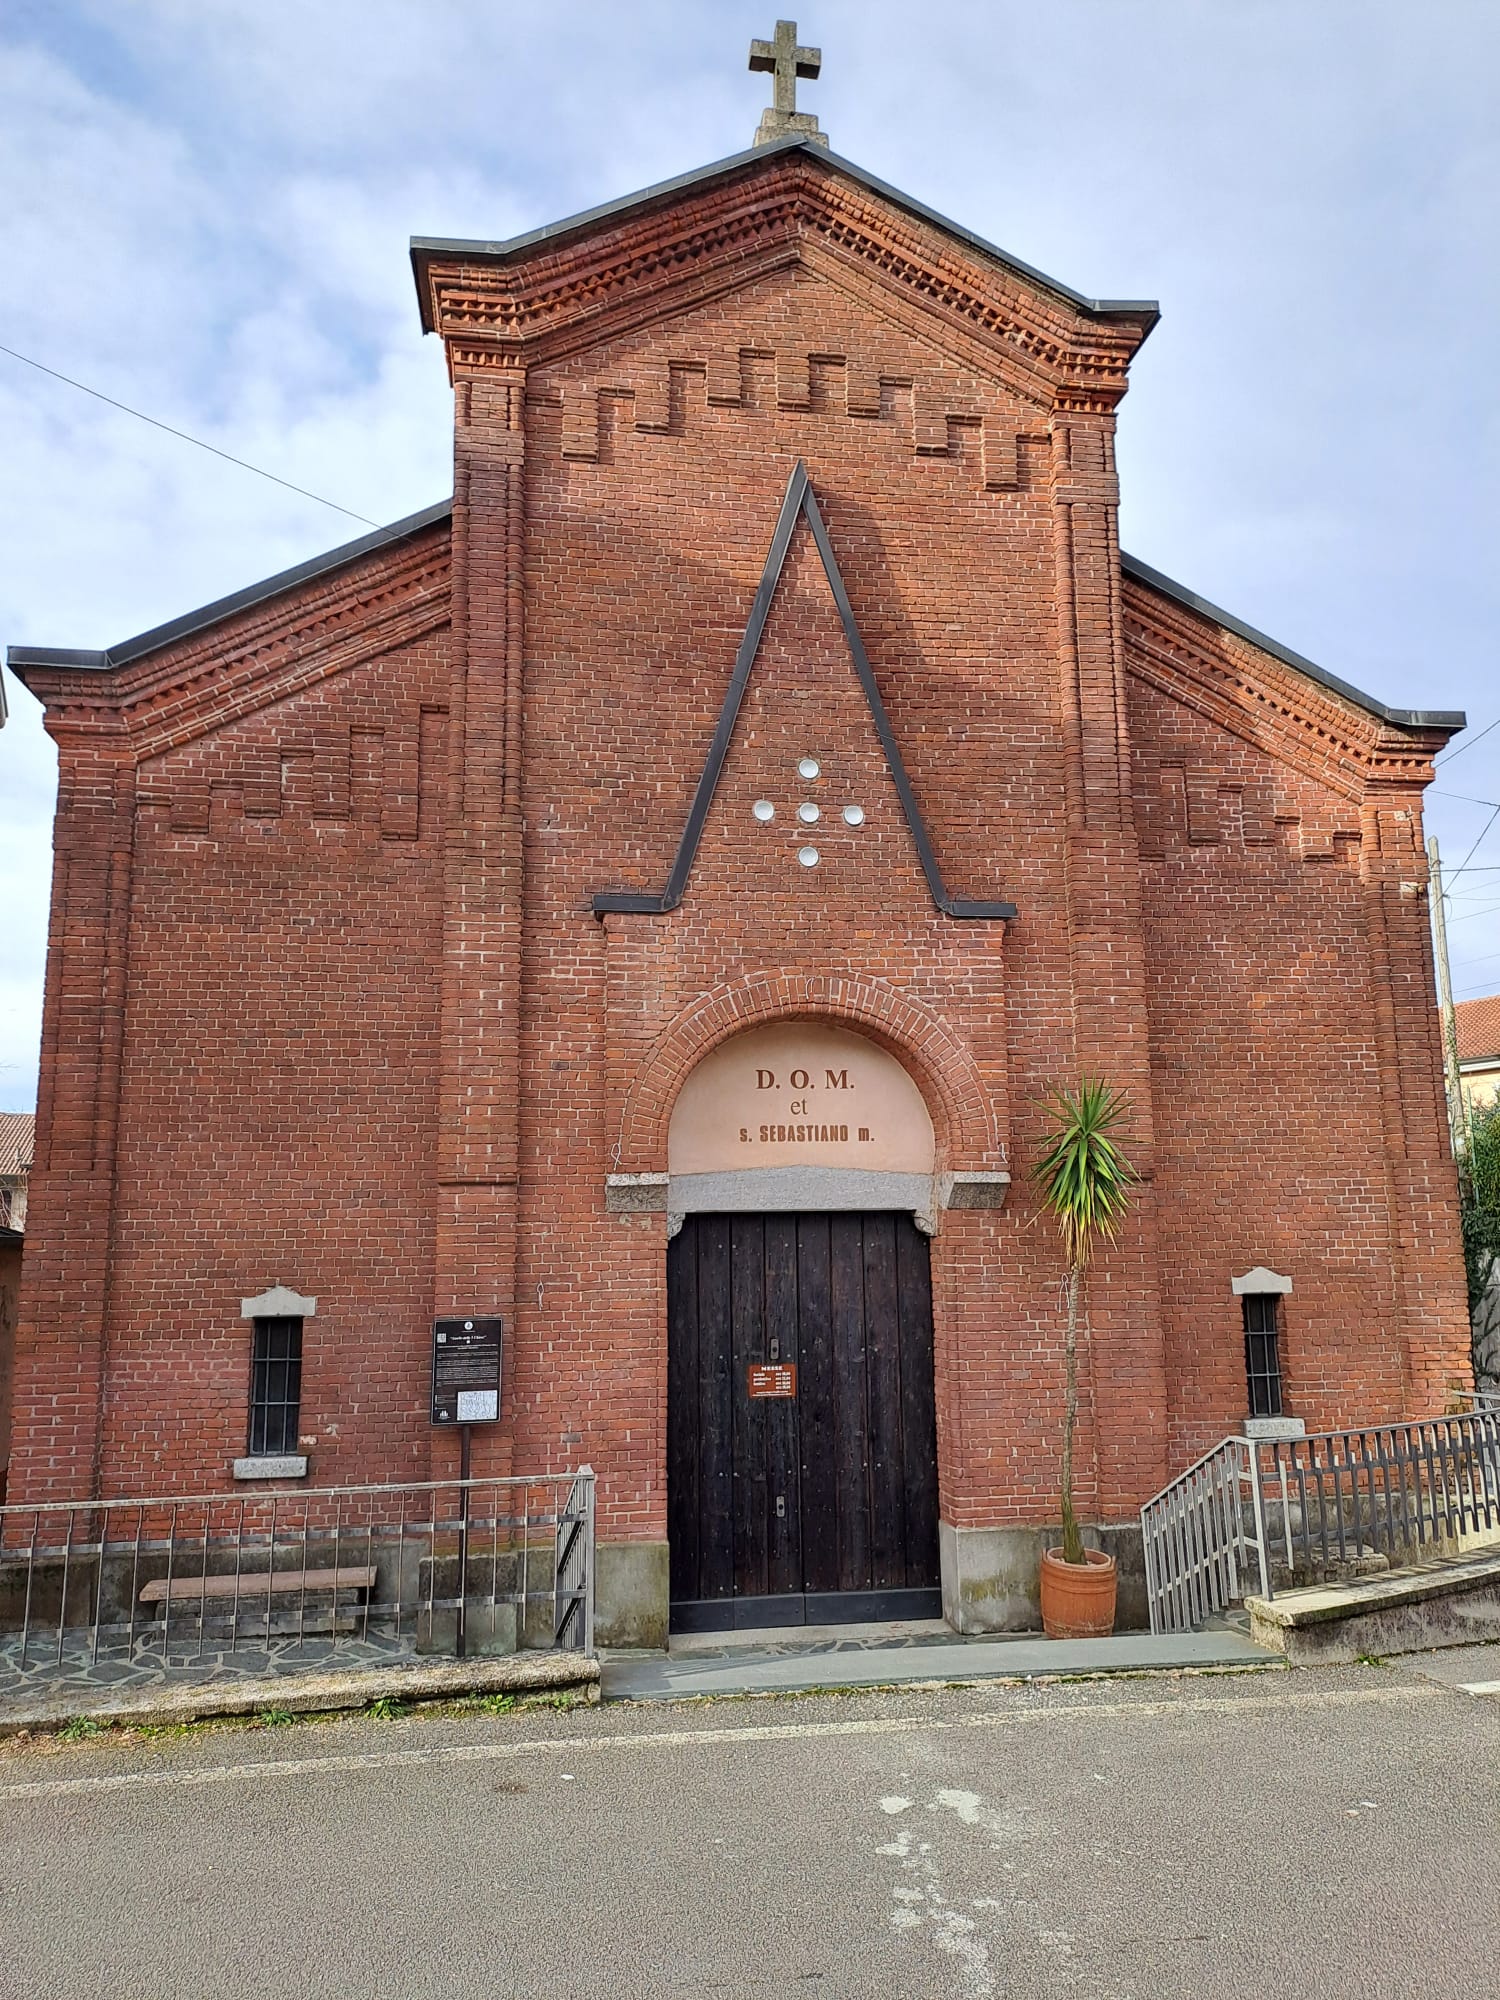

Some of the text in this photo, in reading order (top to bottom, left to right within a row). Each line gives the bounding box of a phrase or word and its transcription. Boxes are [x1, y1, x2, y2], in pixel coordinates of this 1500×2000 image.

[755, 1069, 855, 1089] D. O. M.
[790, 1098, 808, 1115] et
[739, 1125, 875, 1142] s. SEBASTIANO m.
